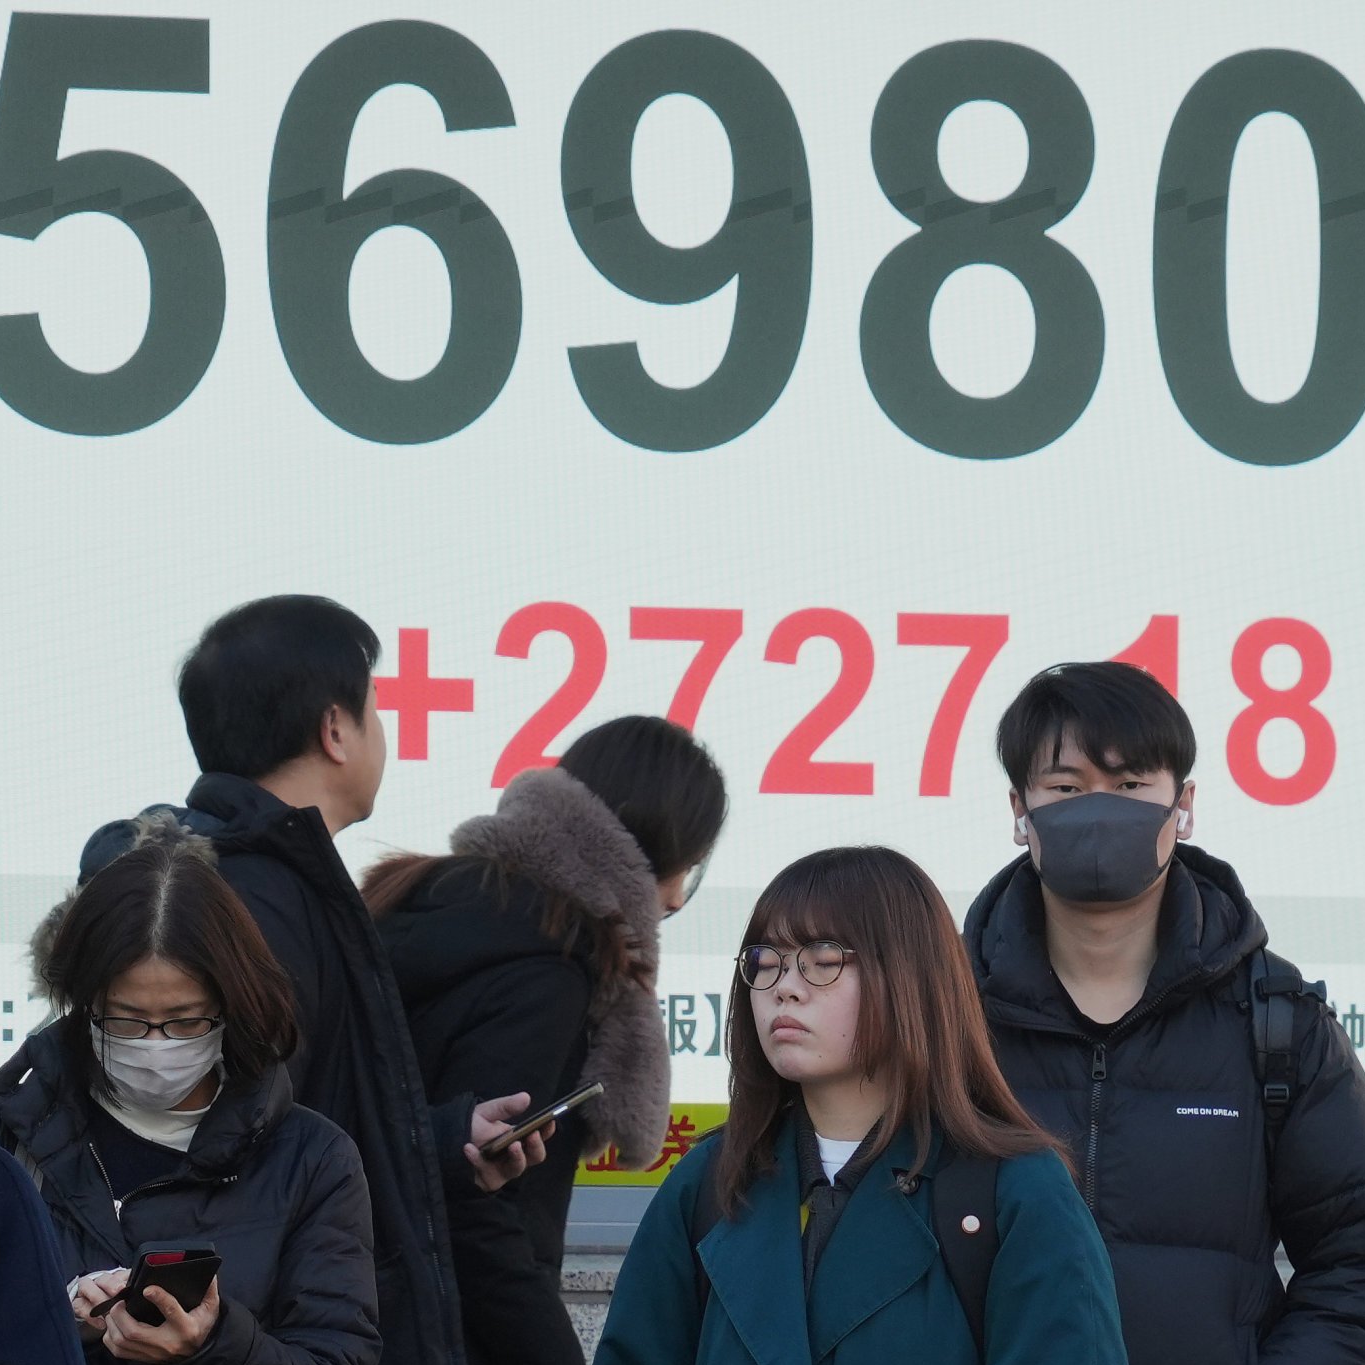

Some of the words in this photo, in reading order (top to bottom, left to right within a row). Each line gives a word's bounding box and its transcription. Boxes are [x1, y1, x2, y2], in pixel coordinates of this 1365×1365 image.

[373, 601, 1337, 806] +27278
[1176, 1107, 1199, 1115] COME
[1199, 1107, 1212, 1116] ON
[1213, 1108, 1239, 1118] DREAM
